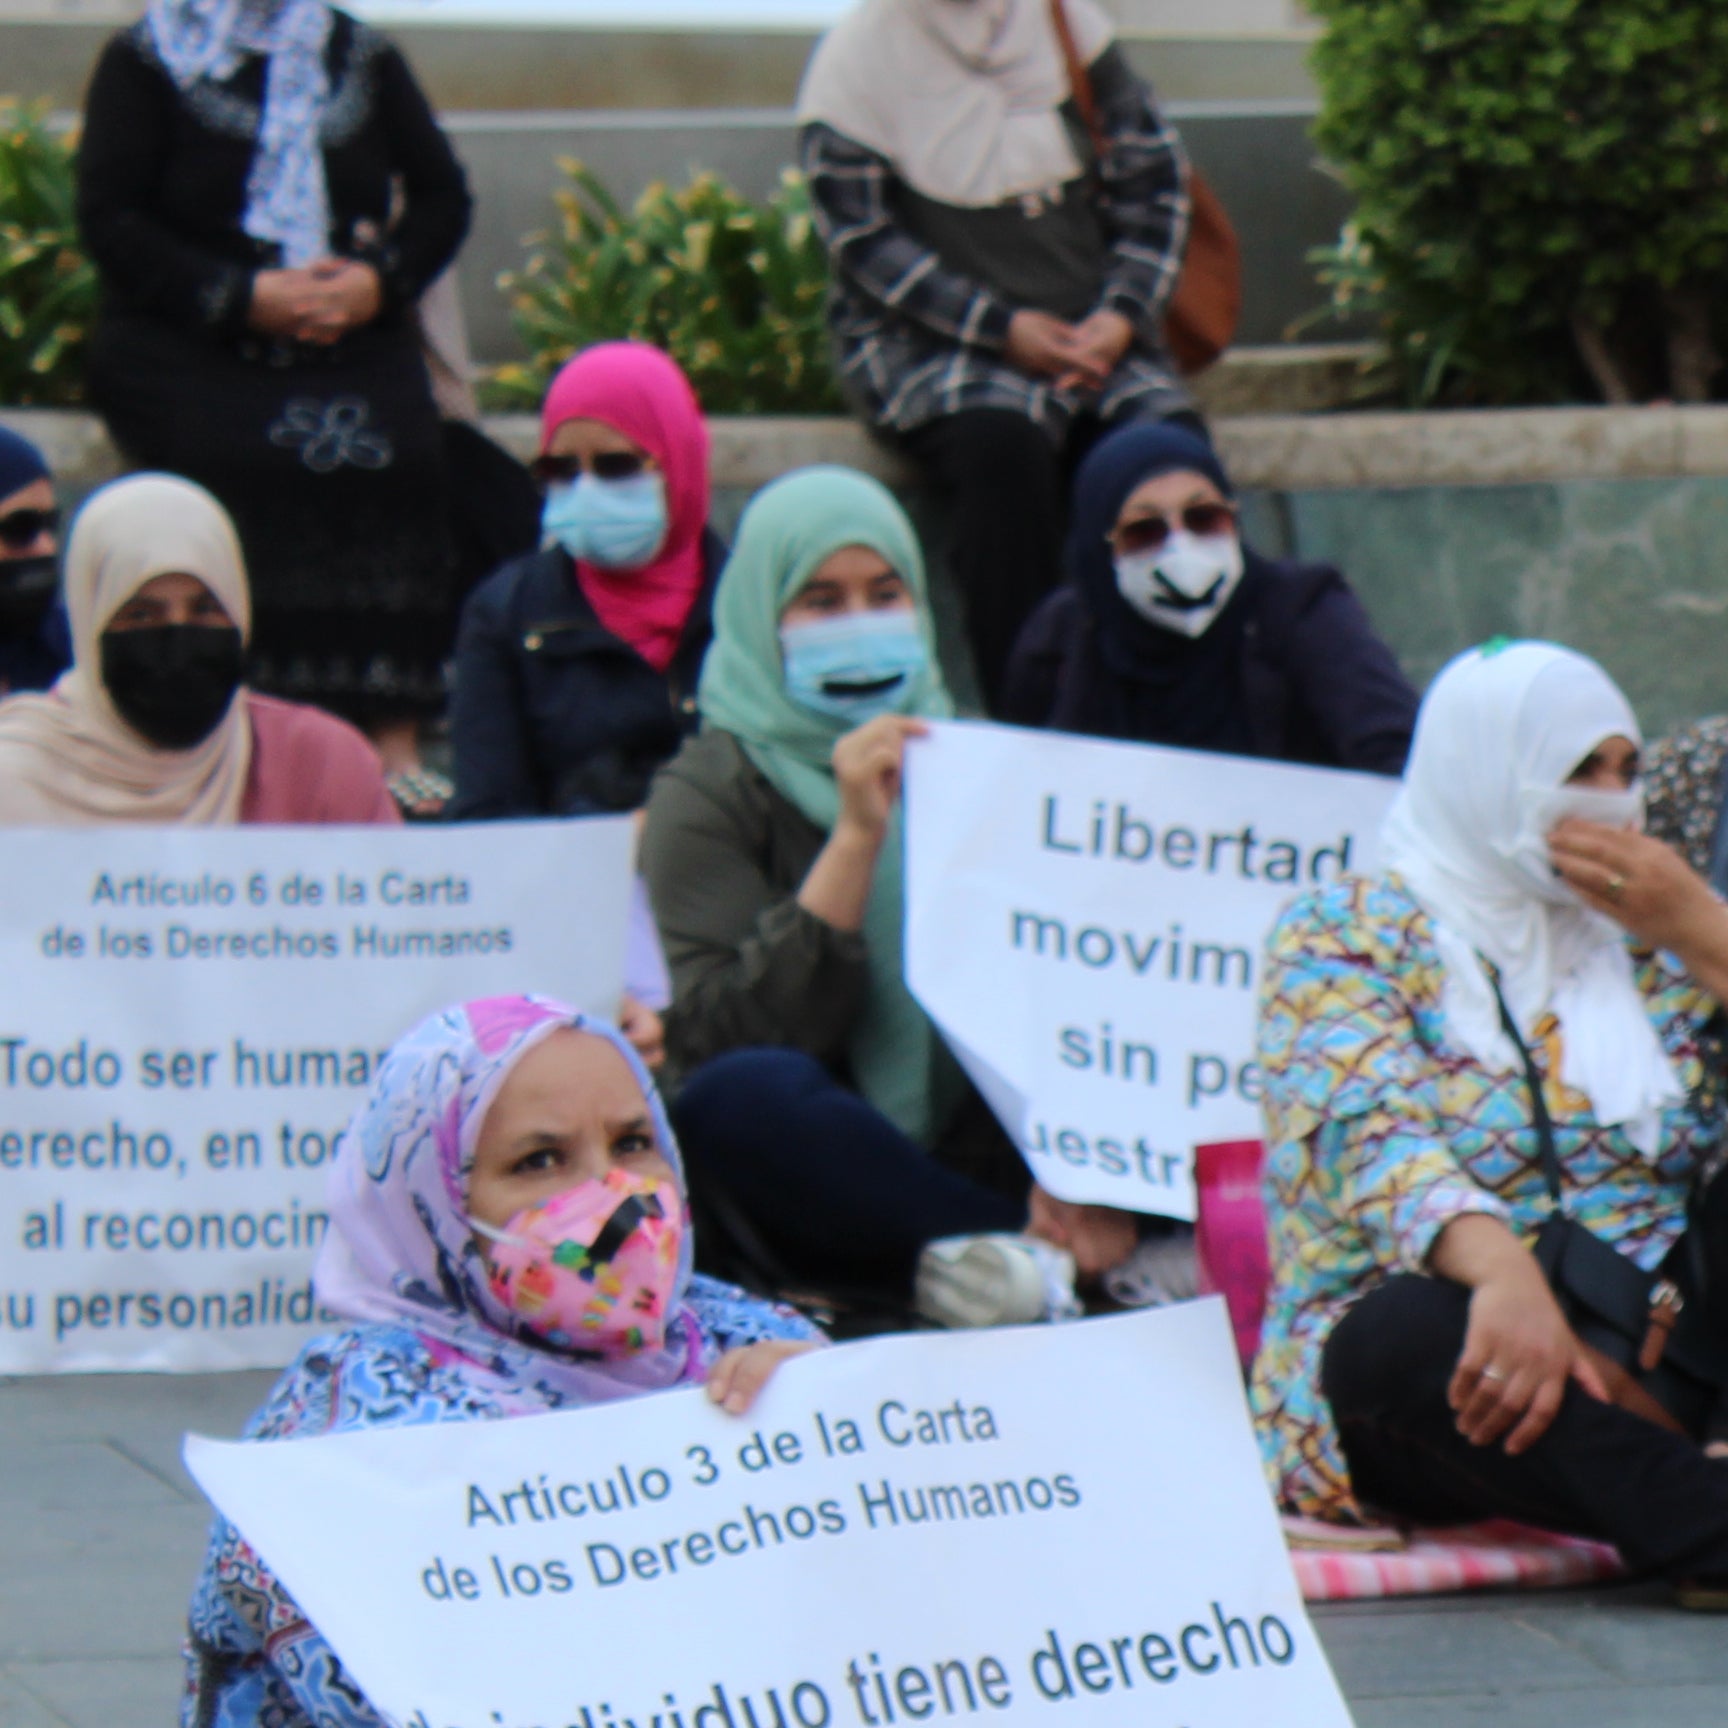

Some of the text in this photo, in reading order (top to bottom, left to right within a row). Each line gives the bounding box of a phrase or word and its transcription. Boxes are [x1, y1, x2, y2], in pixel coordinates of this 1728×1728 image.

[1041, 794, 1355, 884] Libertad
[92, 872, 470, 906] Artículo 6 de la Carta
[42, 925, 513, 959] de los Derechos Humanos
[1010, 910, 1253, 989] movim
[0, 1038, 122, 1088] Todo
[140, 1050, 217, 1089] ser
[1060, 1023, 1158, 1085] sin
[0, 1120, 188, 1178] erecho,
[205, 1132, 261, 1169] en
[23, 1202, 64, 1249] al
[467, 1399, 999, 1528] Artículo 3 de la Carta
[421, 1473, 1082, 1601] de los Derechos Humanos
[846, 1652, 1013, 1728] tiene
[1030, 1600, 1296, 1702] derecho
